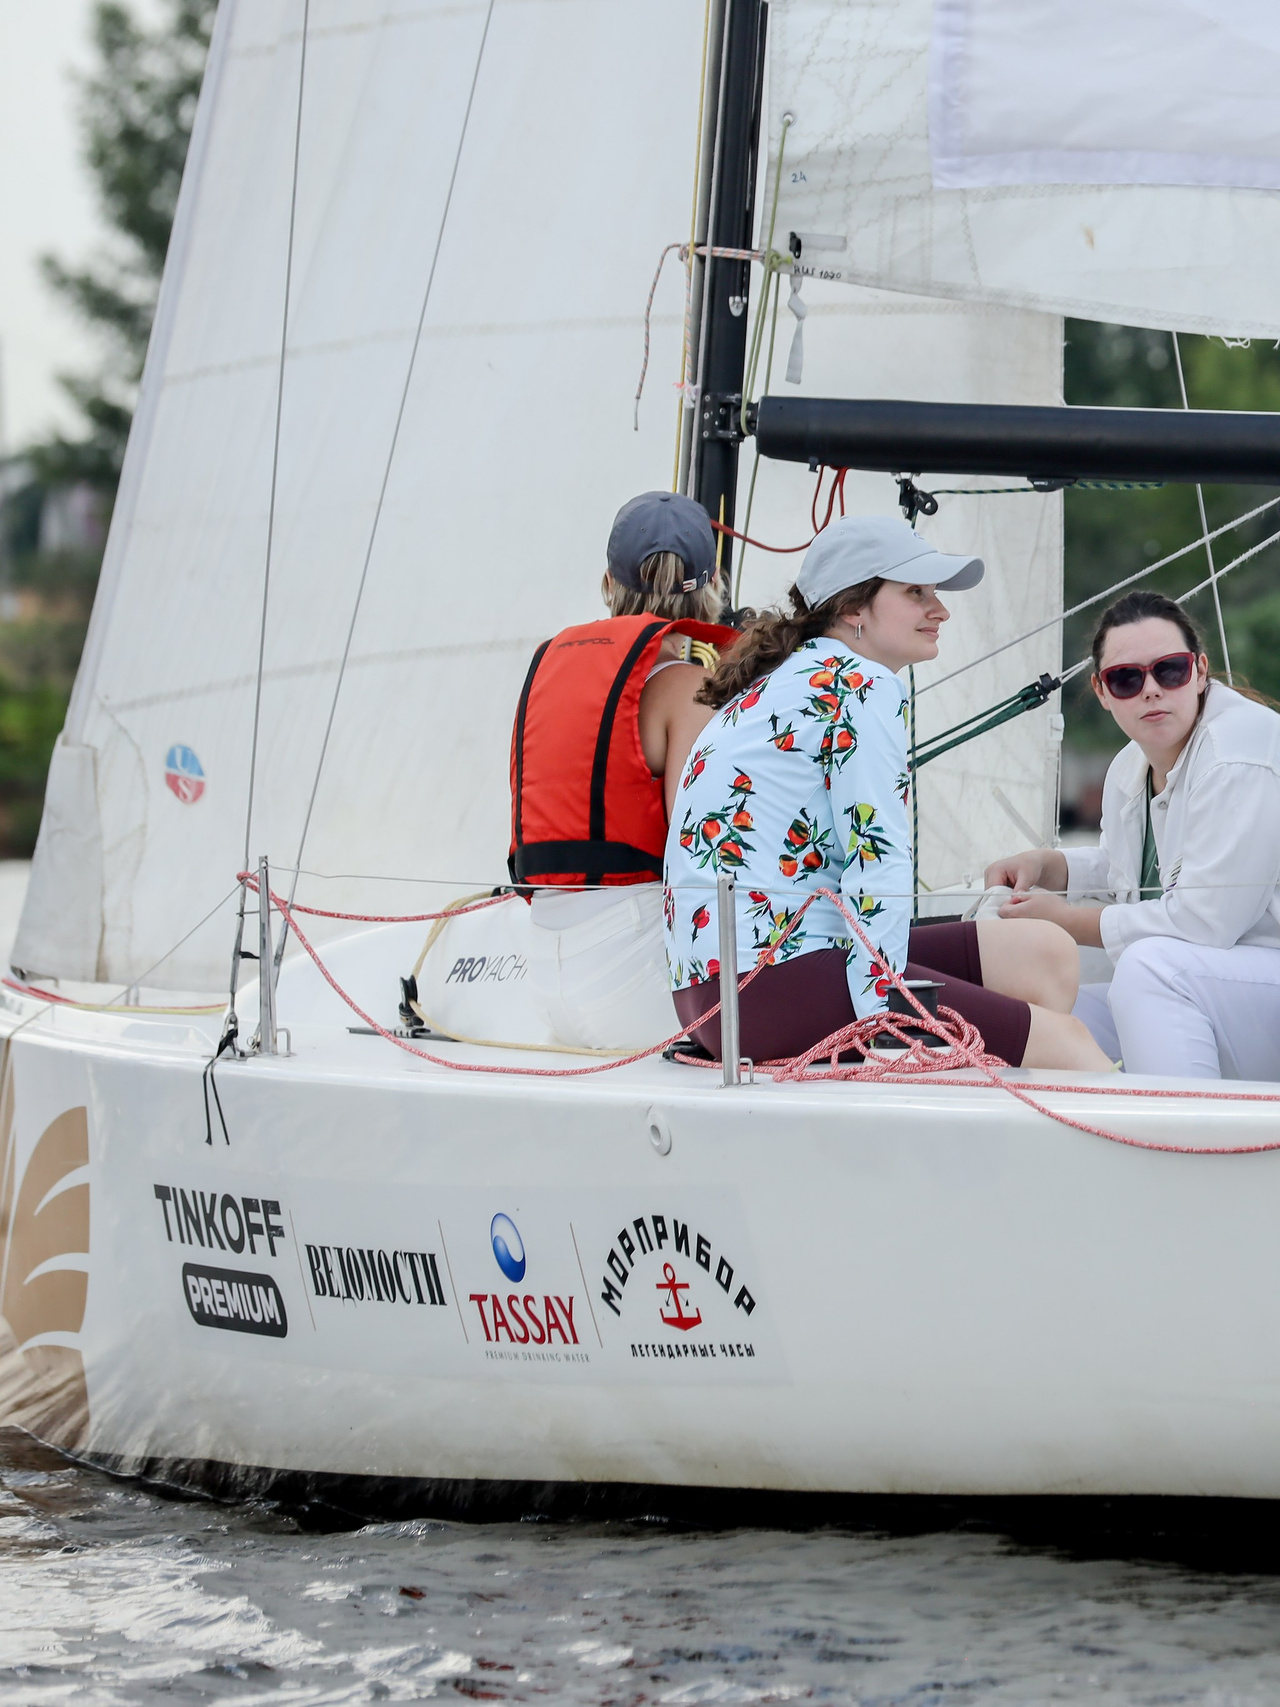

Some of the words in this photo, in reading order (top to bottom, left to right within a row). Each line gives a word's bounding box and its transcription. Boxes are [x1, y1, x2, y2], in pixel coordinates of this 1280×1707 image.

[791, 171, 807, 183] 24
[445, 954, 528, 984] PROYACH
[153, 1184, 285, 1257] TINKOFF
[304, 1244, 447, 1308] ВЕДОМОСТИ
[601, 1214, 756, 1317] МОРПРИБОР
[186, 1274, 282, 1326] PREMIUM
[469, 1293, 581, 1345] TASSAY
[484, 1350, 519, 1361] PREMIUM
[521, 1351, 562, 1363] DRINKING
[563, 1353, 591, 1363] WATER
[630, 1343, 716, 1360] ЛЕГЕНДАРНЫЕ
[719, 1343, 756, 1358] ЧАСЫ
